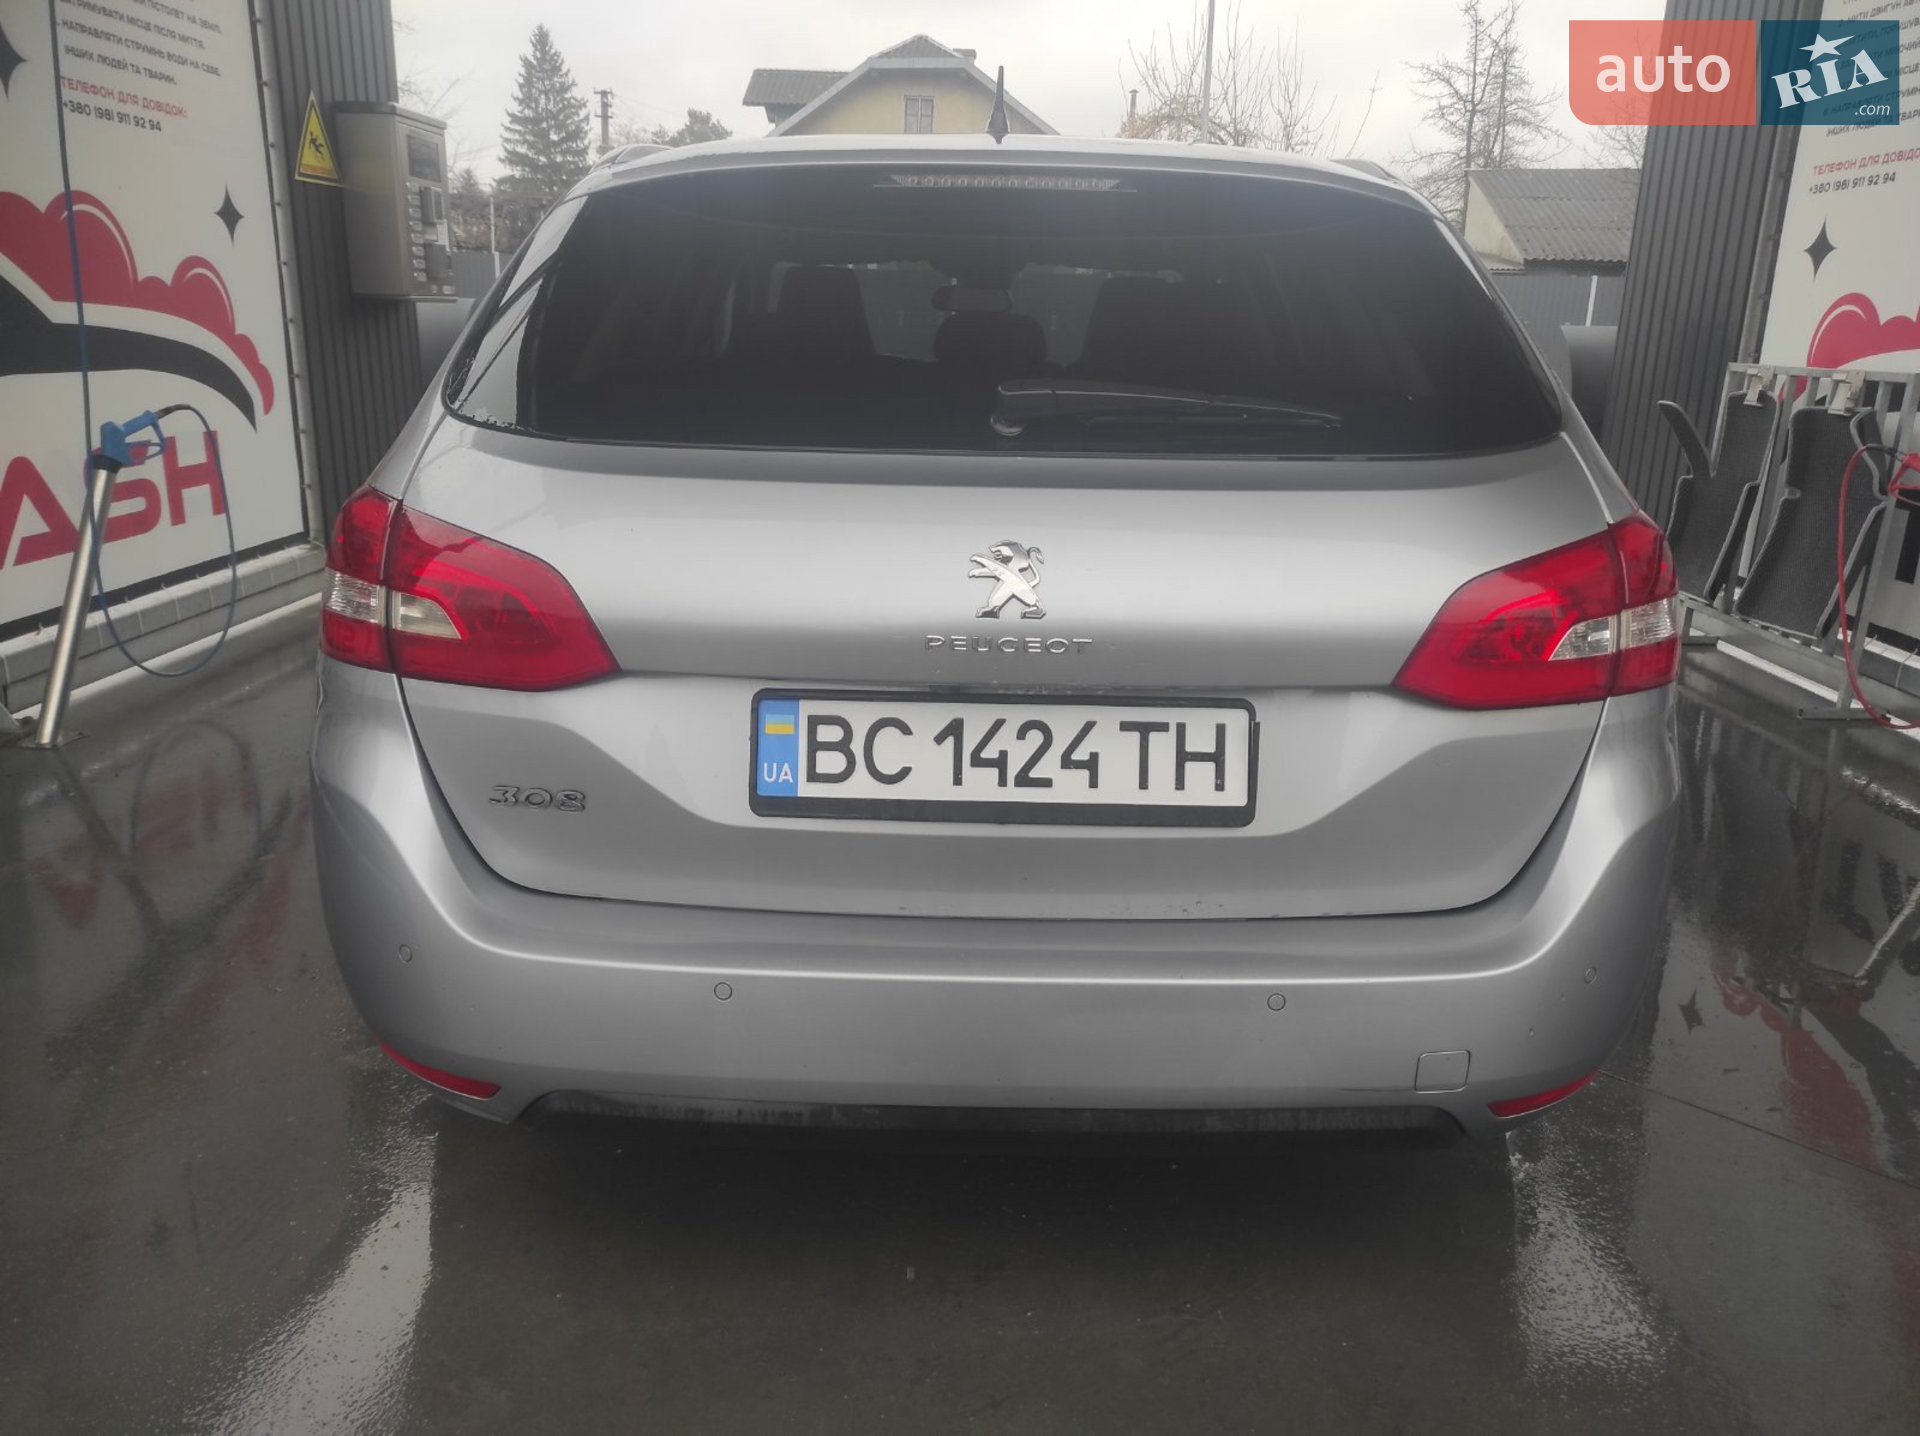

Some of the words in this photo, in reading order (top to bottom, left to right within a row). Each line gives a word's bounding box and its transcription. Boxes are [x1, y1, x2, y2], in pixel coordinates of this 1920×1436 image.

[61, 18, 124, 46] НАПРАВЛЯТИ
[97, 53, 129, 72] ЛЮДЕЙ
[129, 63, 142, 75] ТА
[60, 75, 115, 100] ТЕЛЕФОН
[117, 90, 140, 107] ДЛЯ
[63, 100, 92, 117] +380
[116, 111, 132, 126] 911
[133, 115, 147, 130] 92
[148, 118, 162, 133] 94
[1813, 158, 1857, 176] ТЕЛЕФОН
[1858, 154, 1881, 171] ДЛЯ
[1809, 182, 1831, 195] +380
[1852, 176, 1866, 189] 911
[1867, 173, 1881, 186] 92
[1882, 171, 1897, 184] 94
[925, 635, 1092, 653] PEUGEOT
[763, 761, 794, 783] UA
[806, 714, 913, 785] BC
[933, 717, 1099, 790] 1424
[1119, 720, 1226, 792] TH
[488, 785, 586, 812] 308
